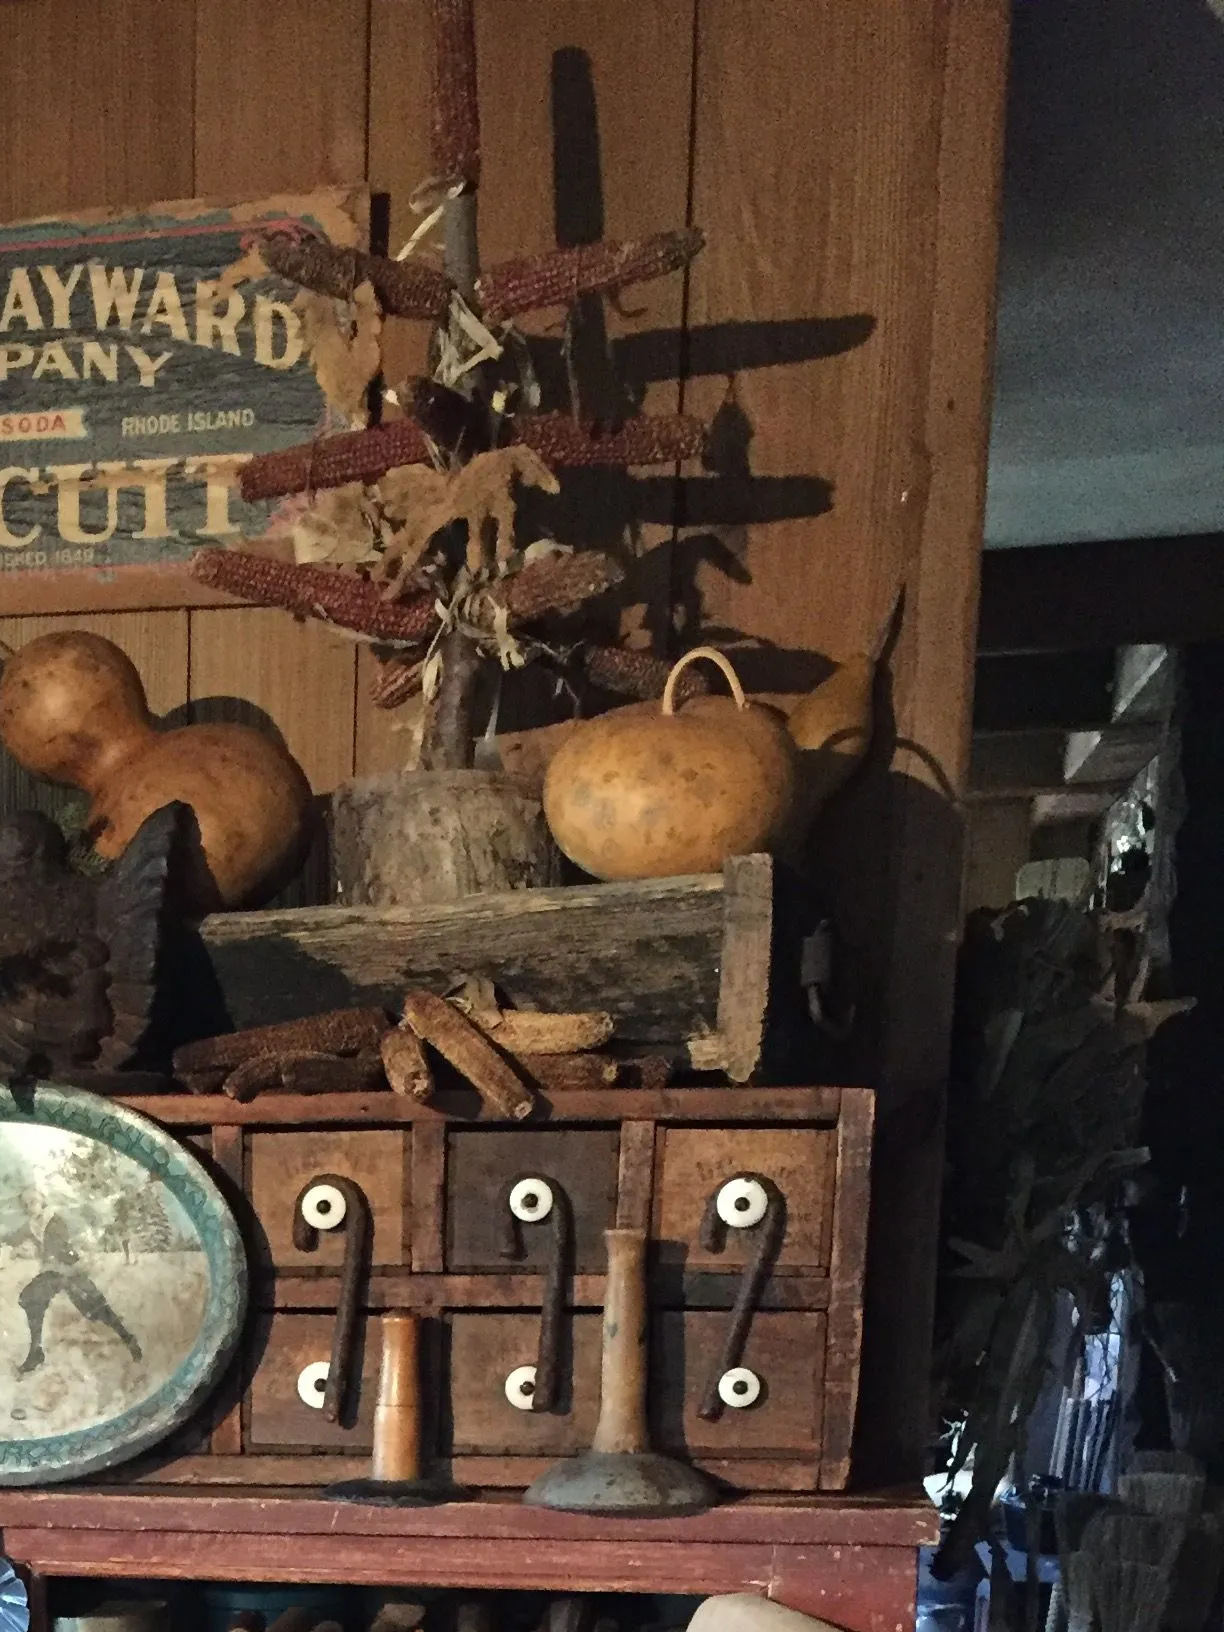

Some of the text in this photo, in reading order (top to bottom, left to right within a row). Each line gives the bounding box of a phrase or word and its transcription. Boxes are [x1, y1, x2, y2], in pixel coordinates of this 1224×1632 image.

[1, 414, 66, 434] SODA
[122, 417, 180, 437] RHODE
[187, 408, 255, 431] ISLAND
